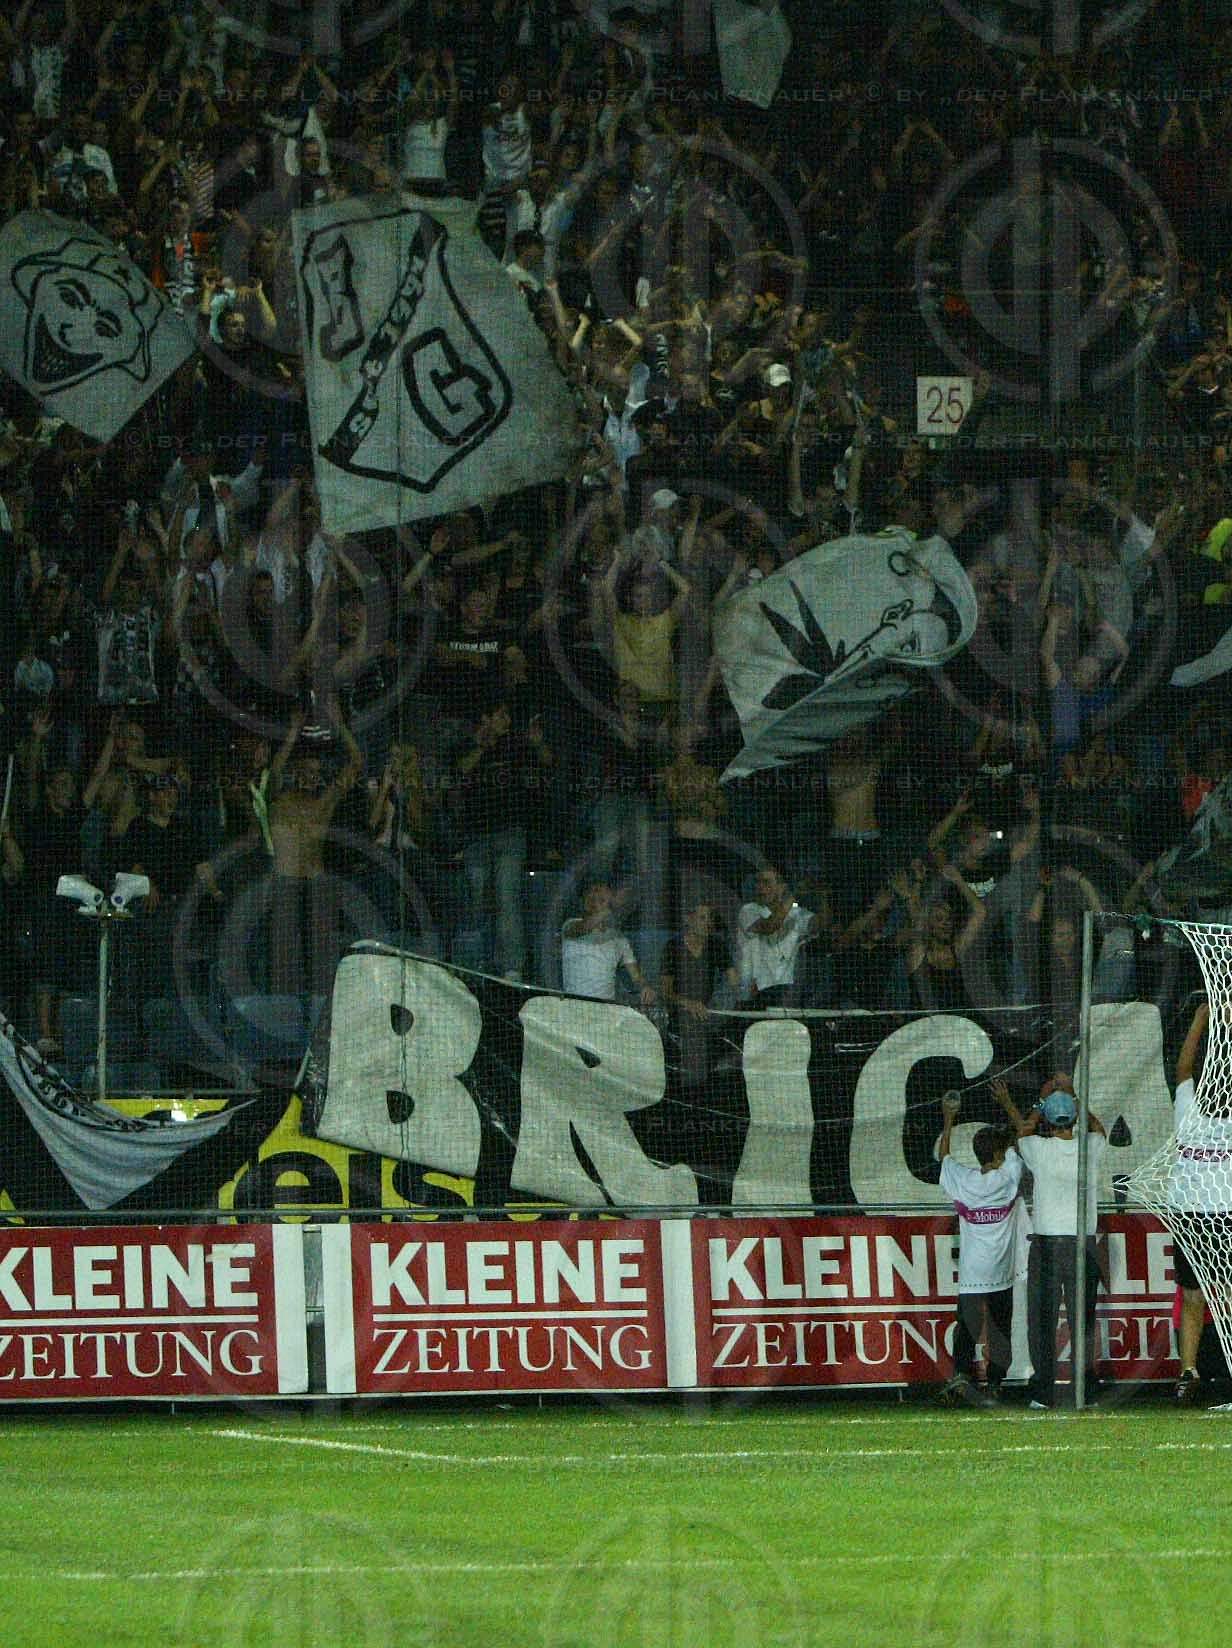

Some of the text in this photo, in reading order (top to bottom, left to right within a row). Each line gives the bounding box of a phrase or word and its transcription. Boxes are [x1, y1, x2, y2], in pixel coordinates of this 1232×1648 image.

[926, 385, 964, 424] 25
[370, 1239, 648, 1306] KLEINE
[372, 1324, 654, 1375] ZEITUNG
